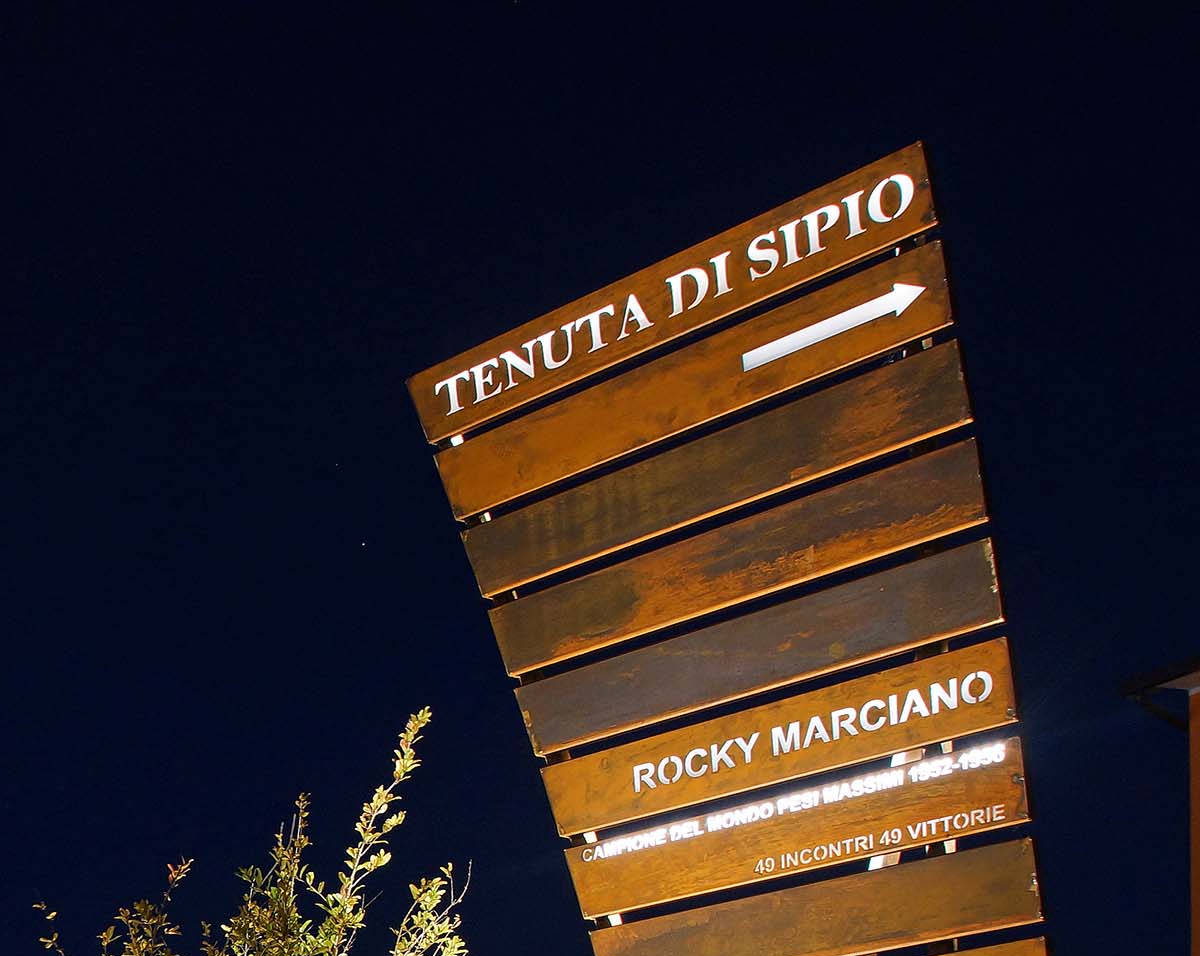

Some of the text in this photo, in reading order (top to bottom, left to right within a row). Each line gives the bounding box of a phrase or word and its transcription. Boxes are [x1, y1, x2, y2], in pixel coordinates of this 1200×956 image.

[435, 173, 915, 416] TENUTA DI SIPIO
[632, 670, 993, 793] ROCKY MARCIANO
[582, 828, 667, 862] CAMPIONE
[669, 820, 704, 842] DEL
[707, 802, 774, 832] MONDO
[777, 791, 819, 815] PESI
[823, 770, 904, 804] MASSIMI
[754, 804, 1006, 874] 49 INCONTRI 49 VITTORIE
